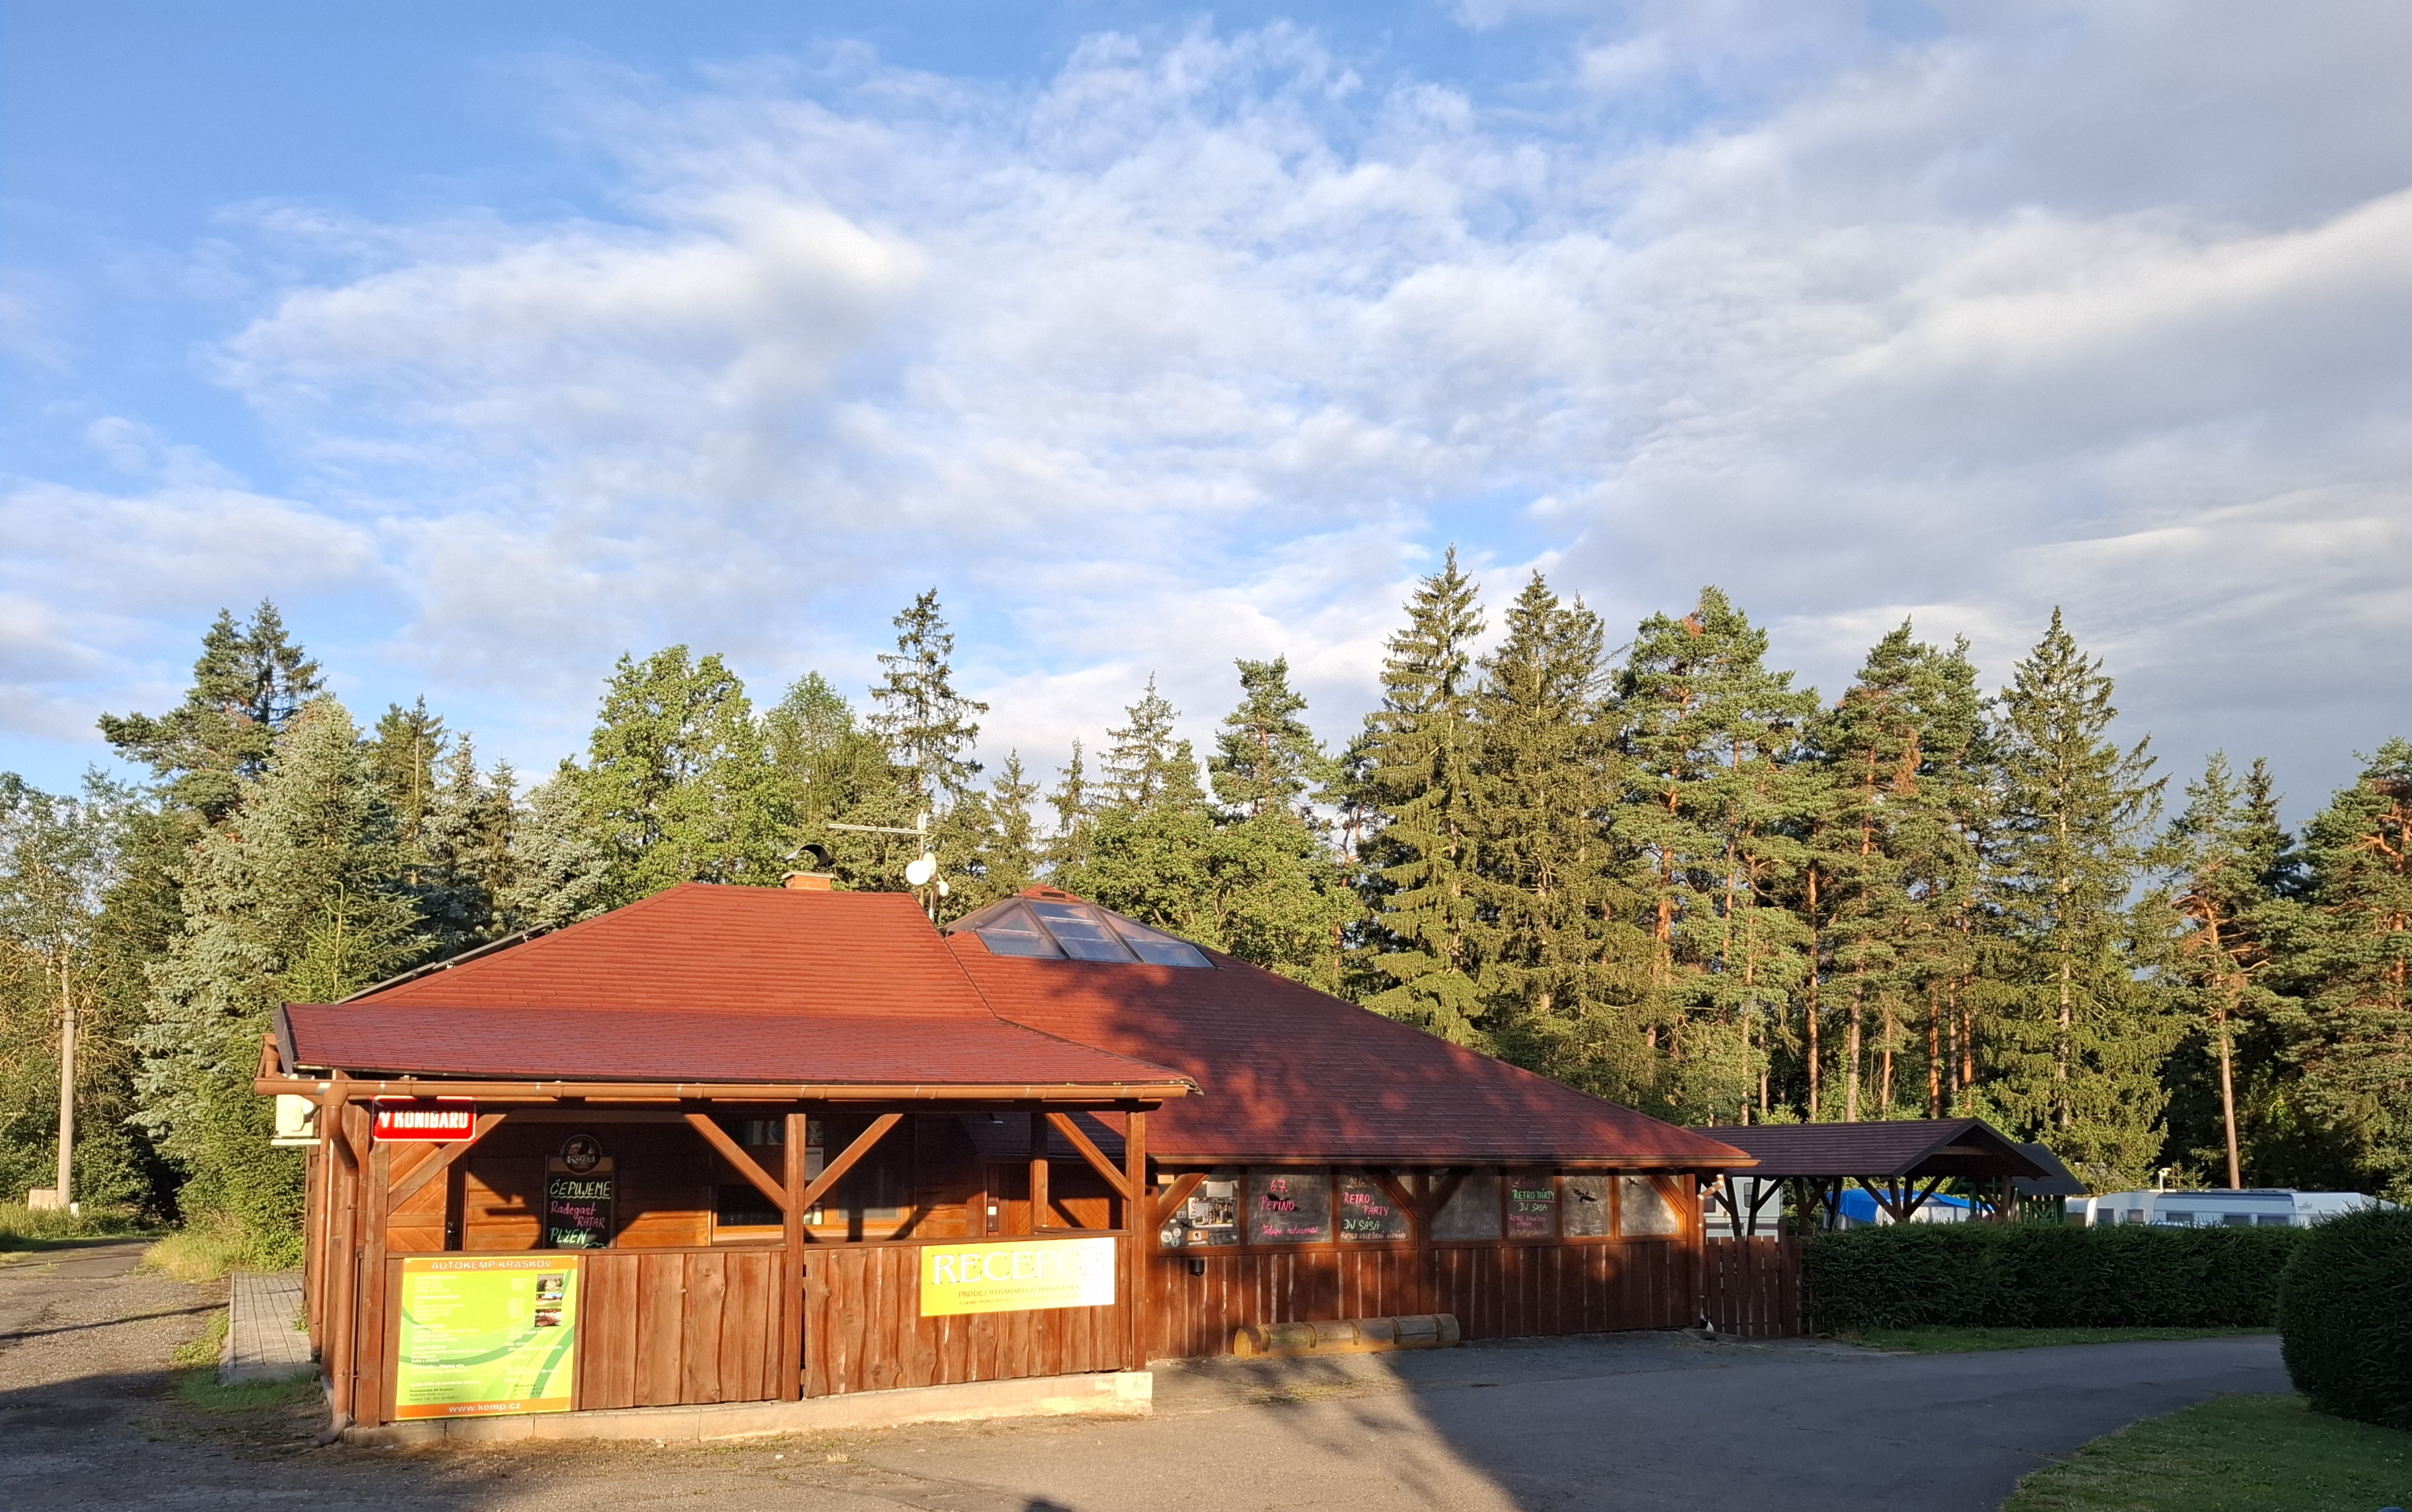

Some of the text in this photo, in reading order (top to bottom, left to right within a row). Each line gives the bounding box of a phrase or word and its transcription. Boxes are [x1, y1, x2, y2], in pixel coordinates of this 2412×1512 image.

[378, 1111, 391, 1128] V
[567, 1155, 596, 1165] Kozel
[550, 1179, 612, 1196] ČEPUJEME
[1343, 1192, 1370, 1204] RETRO
[550, 1200, 596, 1220] Radegast
[431, 1258, 552, 1270] AUTOKEMP KRASKOV
[931, 1247, 1106, 1285] RECEPCE
[448, 1402, 521, 1413] www.kemp.cz
